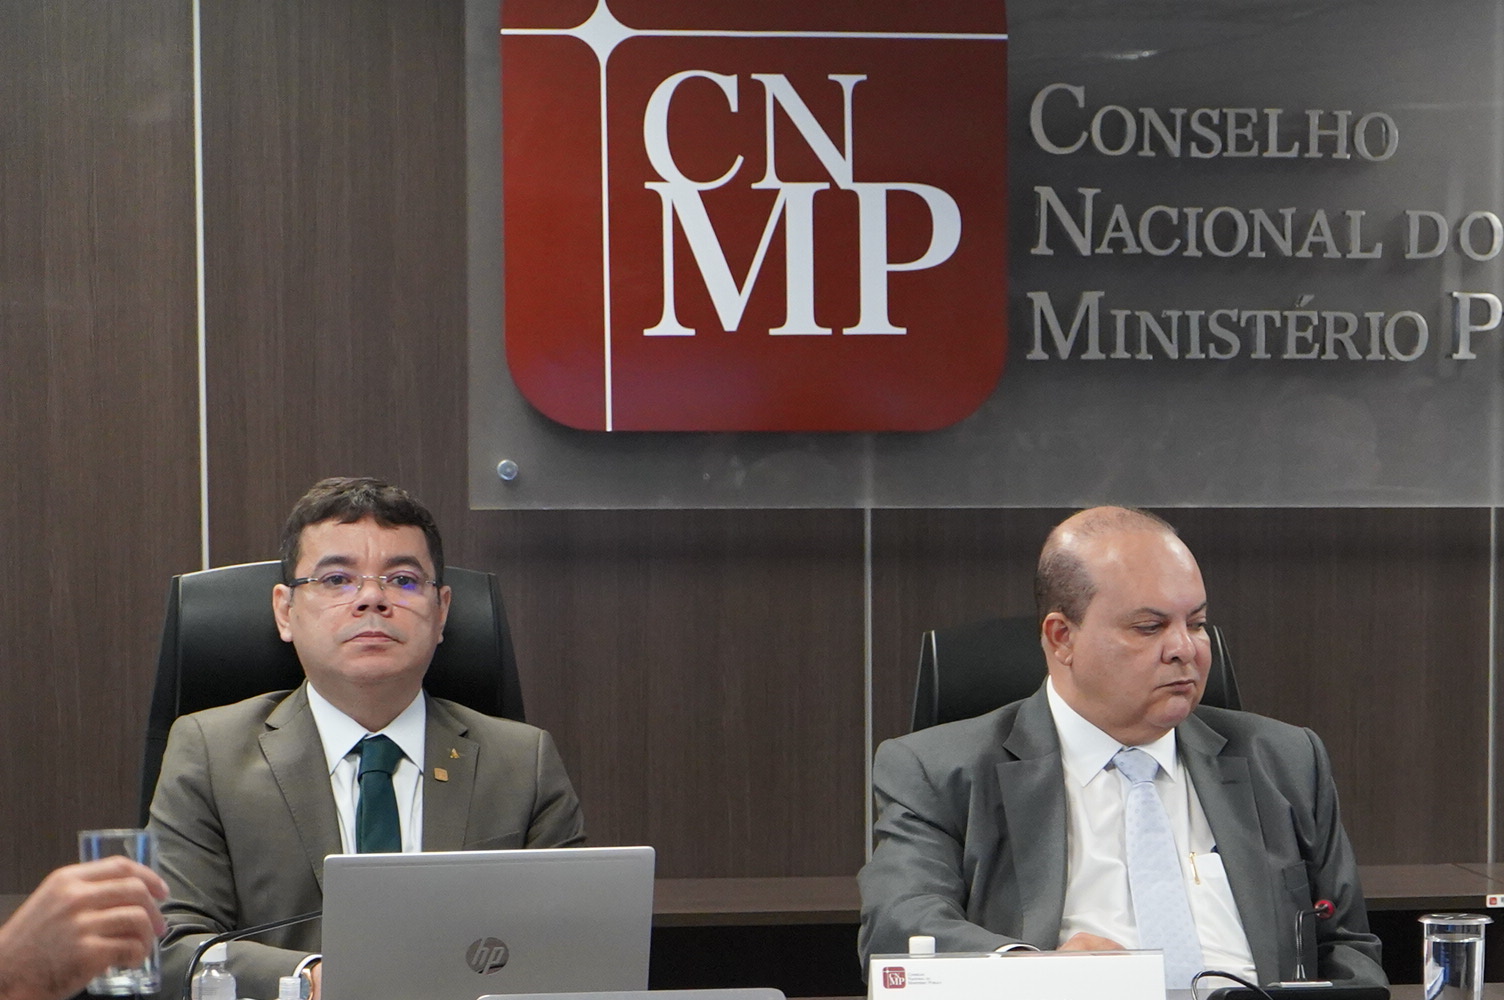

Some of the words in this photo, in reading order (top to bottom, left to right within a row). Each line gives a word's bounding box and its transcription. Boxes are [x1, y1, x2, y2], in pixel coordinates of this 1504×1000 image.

[643, 70, 867, 191] CN
[643, 182, 962, 336] MP
[470, 937, 506, 974] hp
